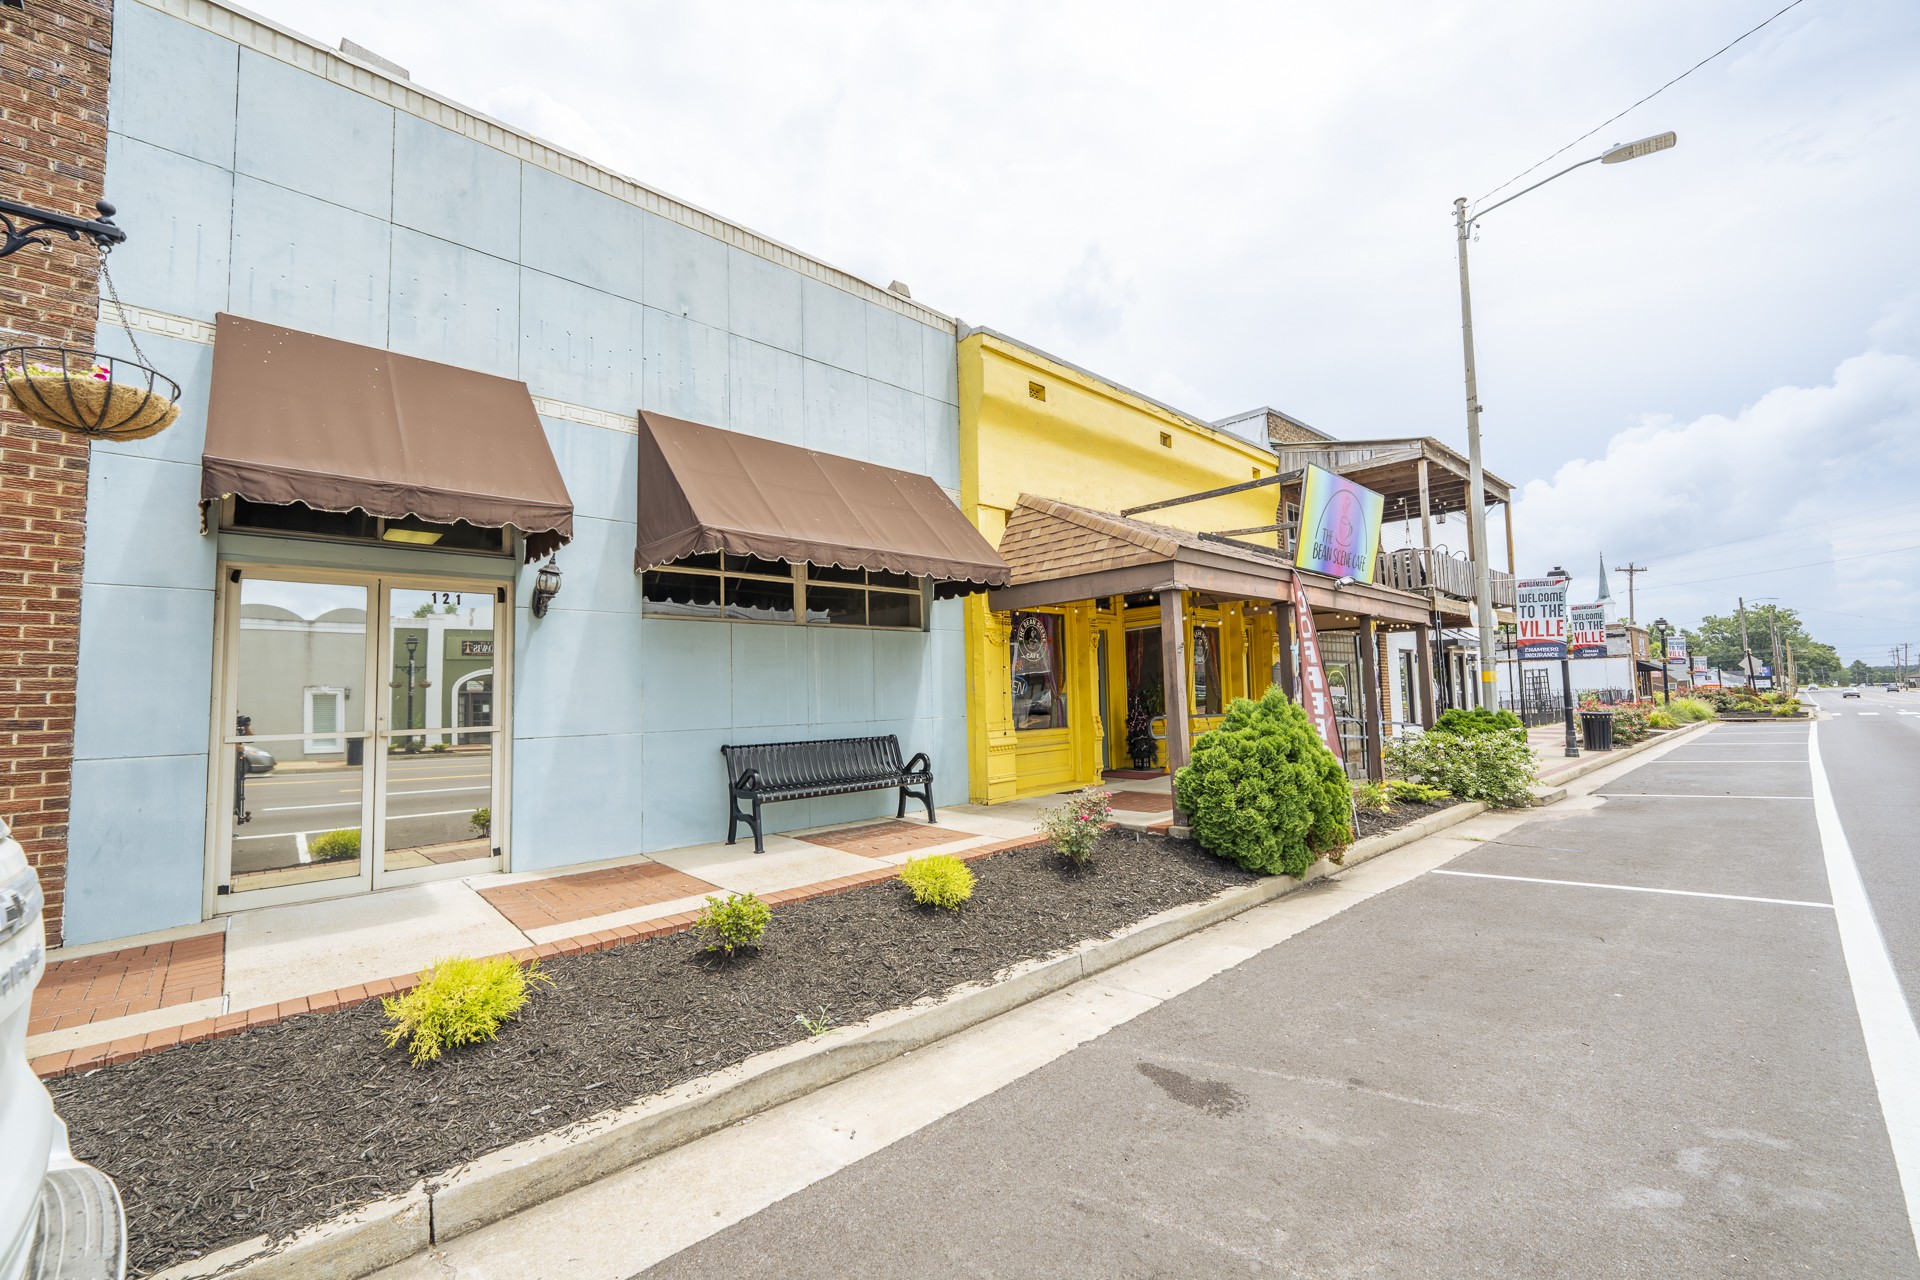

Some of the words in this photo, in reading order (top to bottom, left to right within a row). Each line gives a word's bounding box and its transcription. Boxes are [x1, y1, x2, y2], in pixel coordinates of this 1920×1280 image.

[1322, 528, 1333, 545] THE
[1312, 541, 1333, 561] BEAN
[1333, 548, 1352, 567] SCENE
[1351, 553, 1367, 572] CAFE
[432, 593, 461, 605] 121
[1519, 592, 1563, 603] WELCOME
[1520, 605, 1535, 618] TO
[1541, 604, 1563, 618] THE
[1520, 620, 1564, 637] VILLE
[1573, 622, 1584, 631] TO
[1588, 621, 1604, 630] THE
[1574, 631, 1605, 643] VILLE
